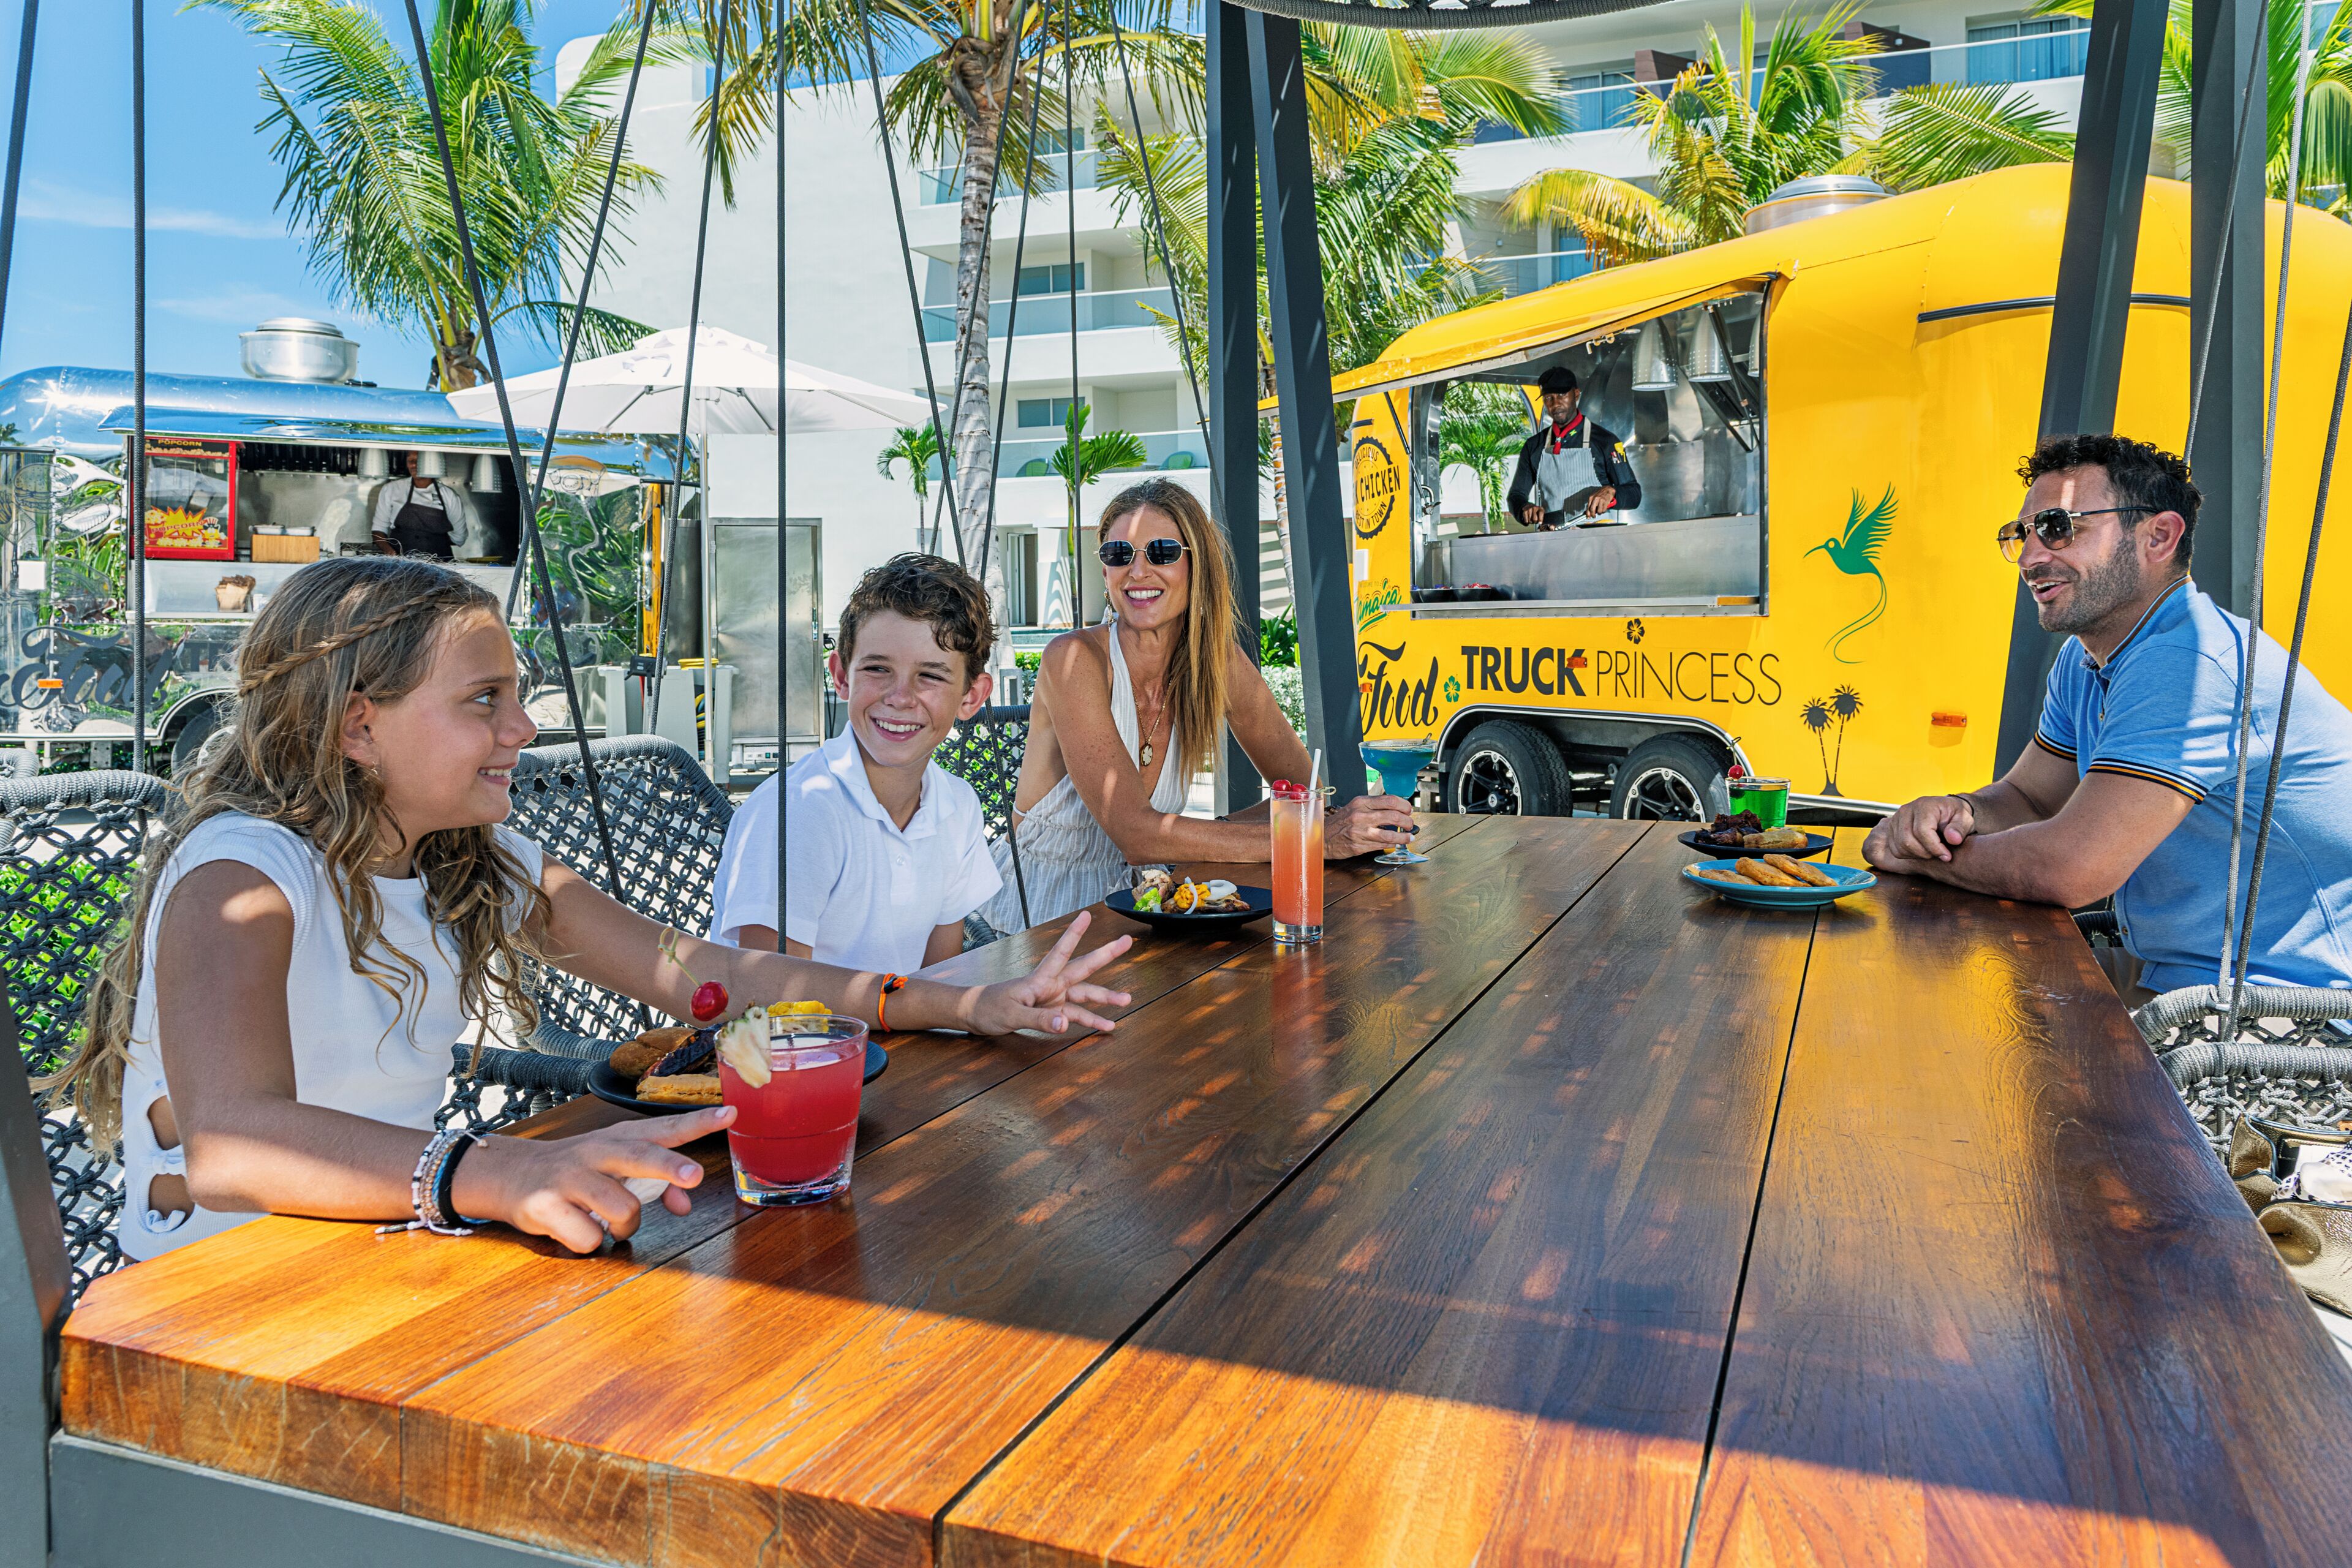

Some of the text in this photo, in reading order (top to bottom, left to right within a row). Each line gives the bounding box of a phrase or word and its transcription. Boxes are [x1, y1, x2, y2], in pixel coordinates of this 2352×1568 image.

[1355, 447, 1379, 469] DELICIOUS
[1360, 466, 1401, 502] CHICKEN
[151, 521, 205, 533] POPCORN
[1365, 519, 1371, 530] IN
[1371, 501, 1387, 526] TOWN
[1358, 641, 1782, 736] Food TRUCK PRINCESS
